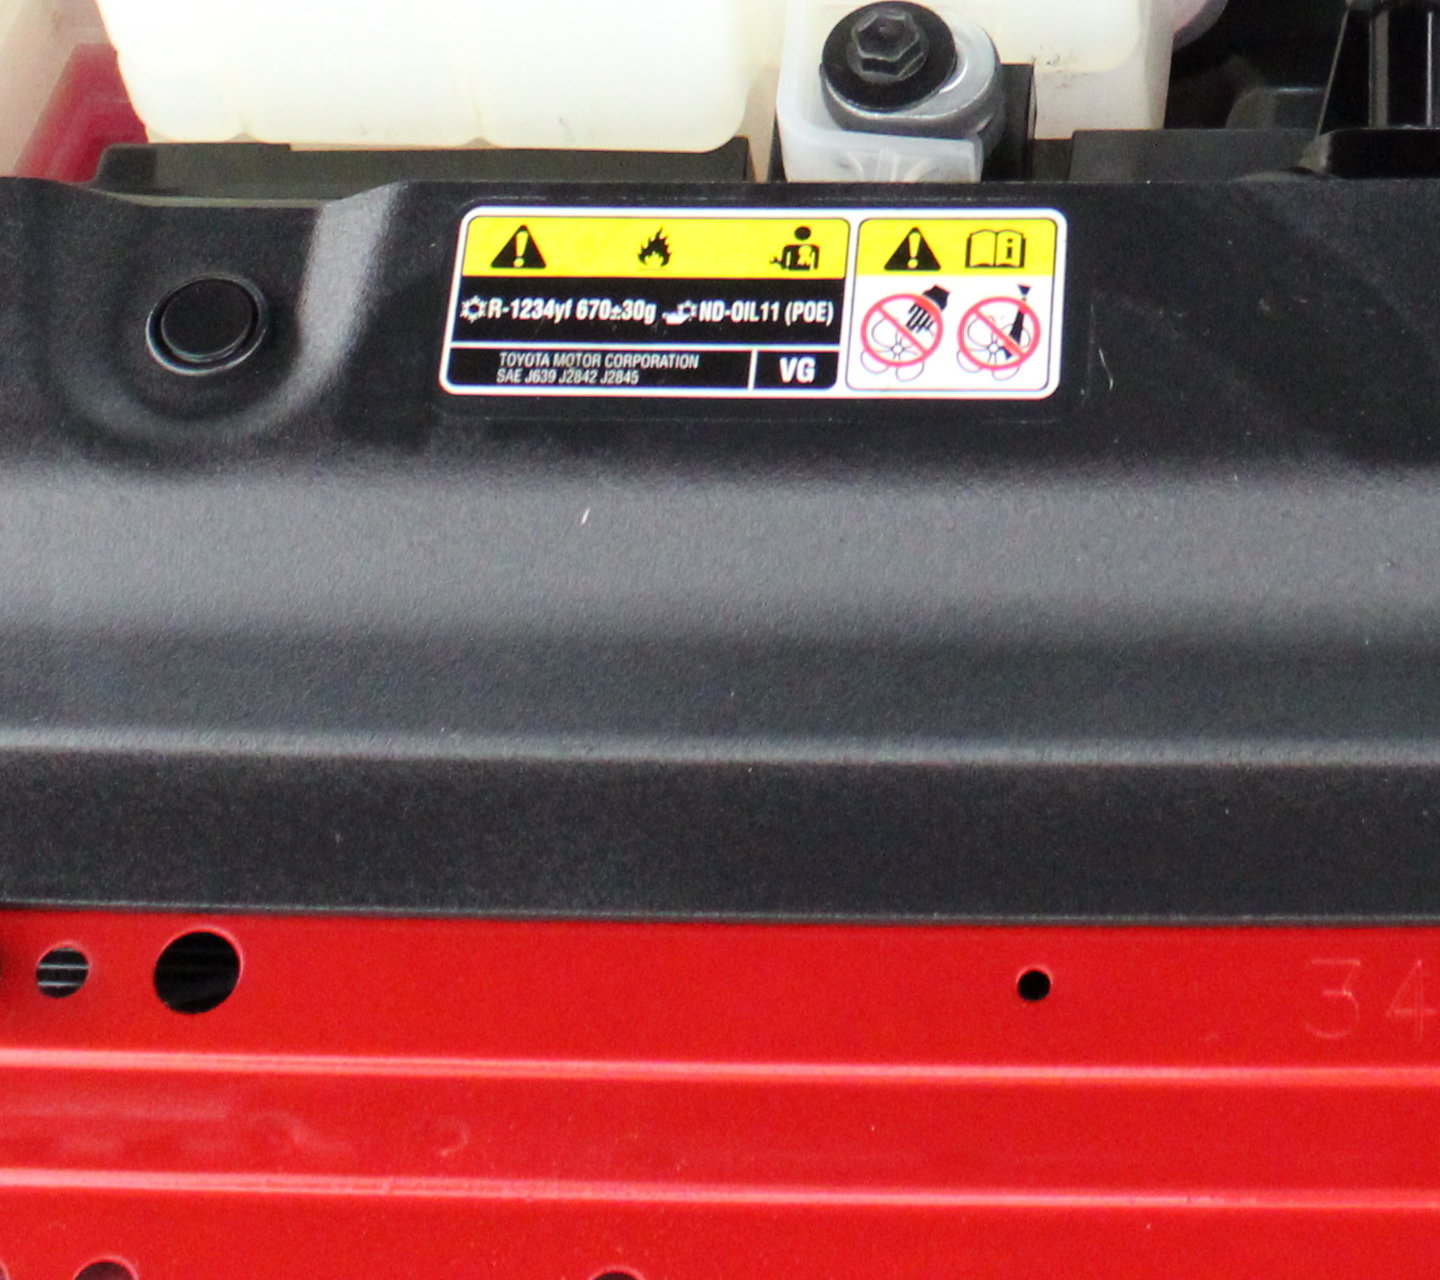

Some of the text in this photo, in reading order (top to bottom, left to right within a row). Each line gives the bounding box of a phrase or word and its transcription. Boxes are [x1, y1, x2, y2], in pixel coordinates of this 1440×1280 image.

[487, 298, 834, 326] R-1234yf 670±30g ND-OIL11 (POE)
[499, 352, 700, 369] TOYOTA MOTOR CORPORATION
[779, 357, 816, 383] VG
[496, 369, 640, 385] SAE J639 J2842 J2845
